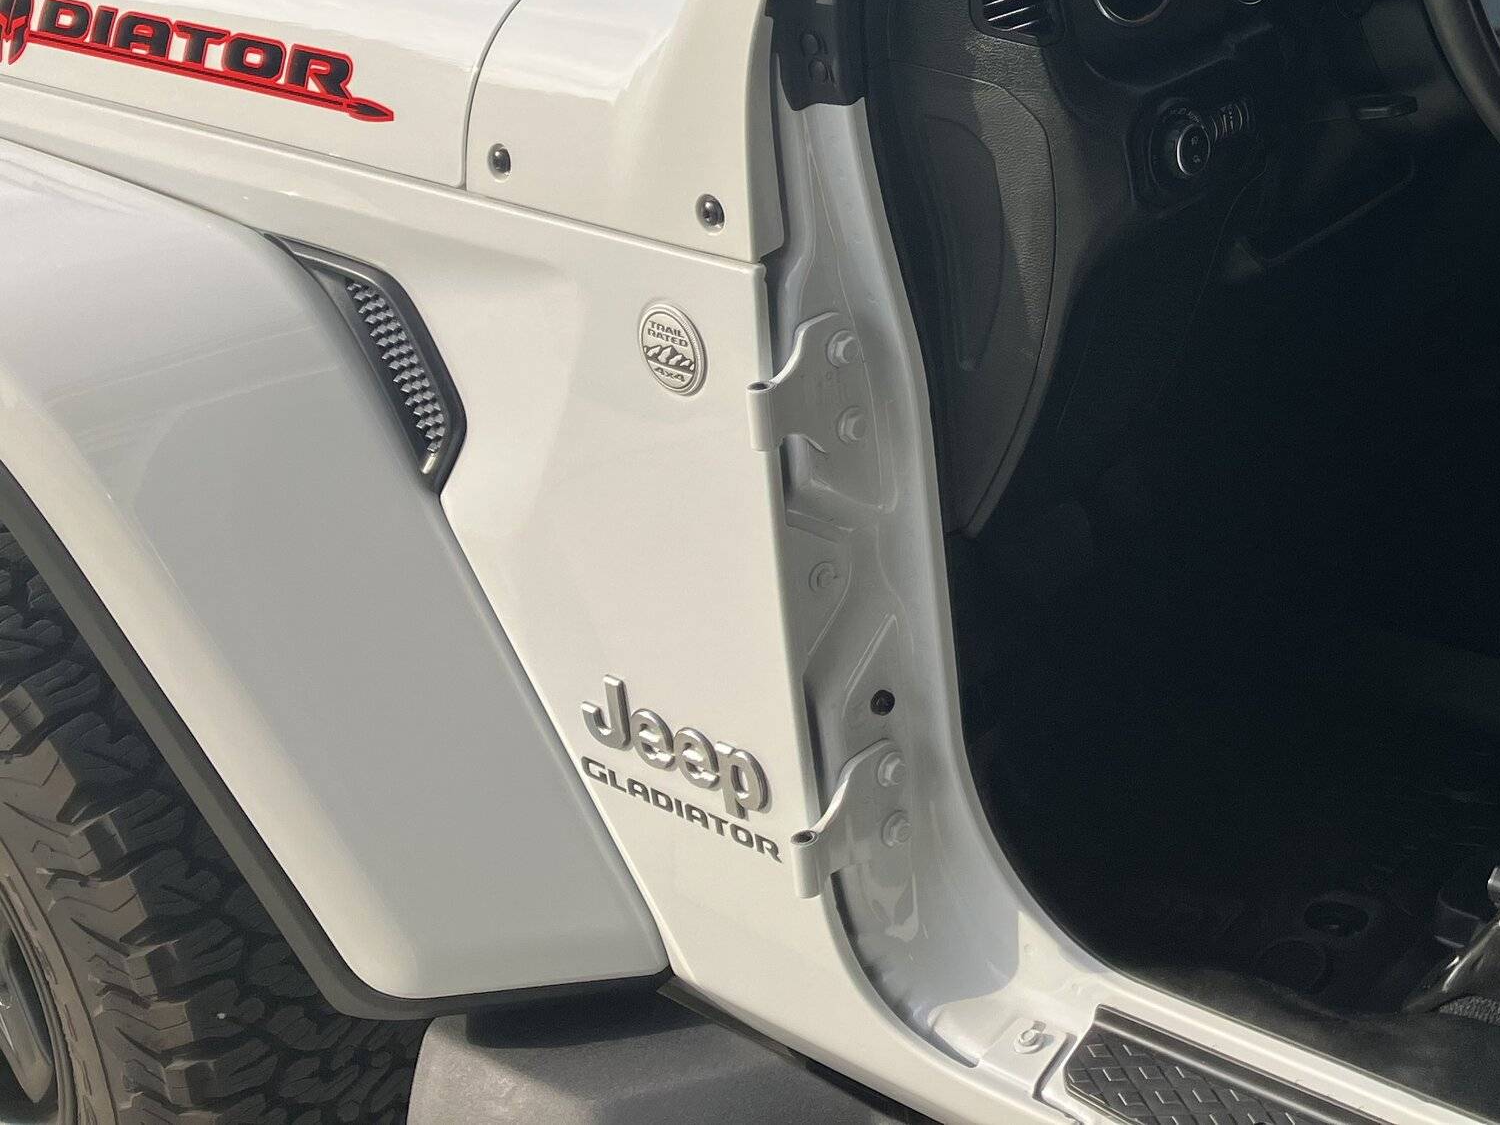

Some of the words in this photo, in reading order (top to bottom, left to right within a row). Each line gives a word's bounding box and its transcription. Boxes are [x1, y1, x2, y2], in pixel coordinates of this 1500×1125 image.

[647, 328, 688, 347] RATED
[649, 320, 685, 339] TRAIL
[581, 674, 771, 820] Jeep
[581, 755, 783, 864] GLADIATOR
